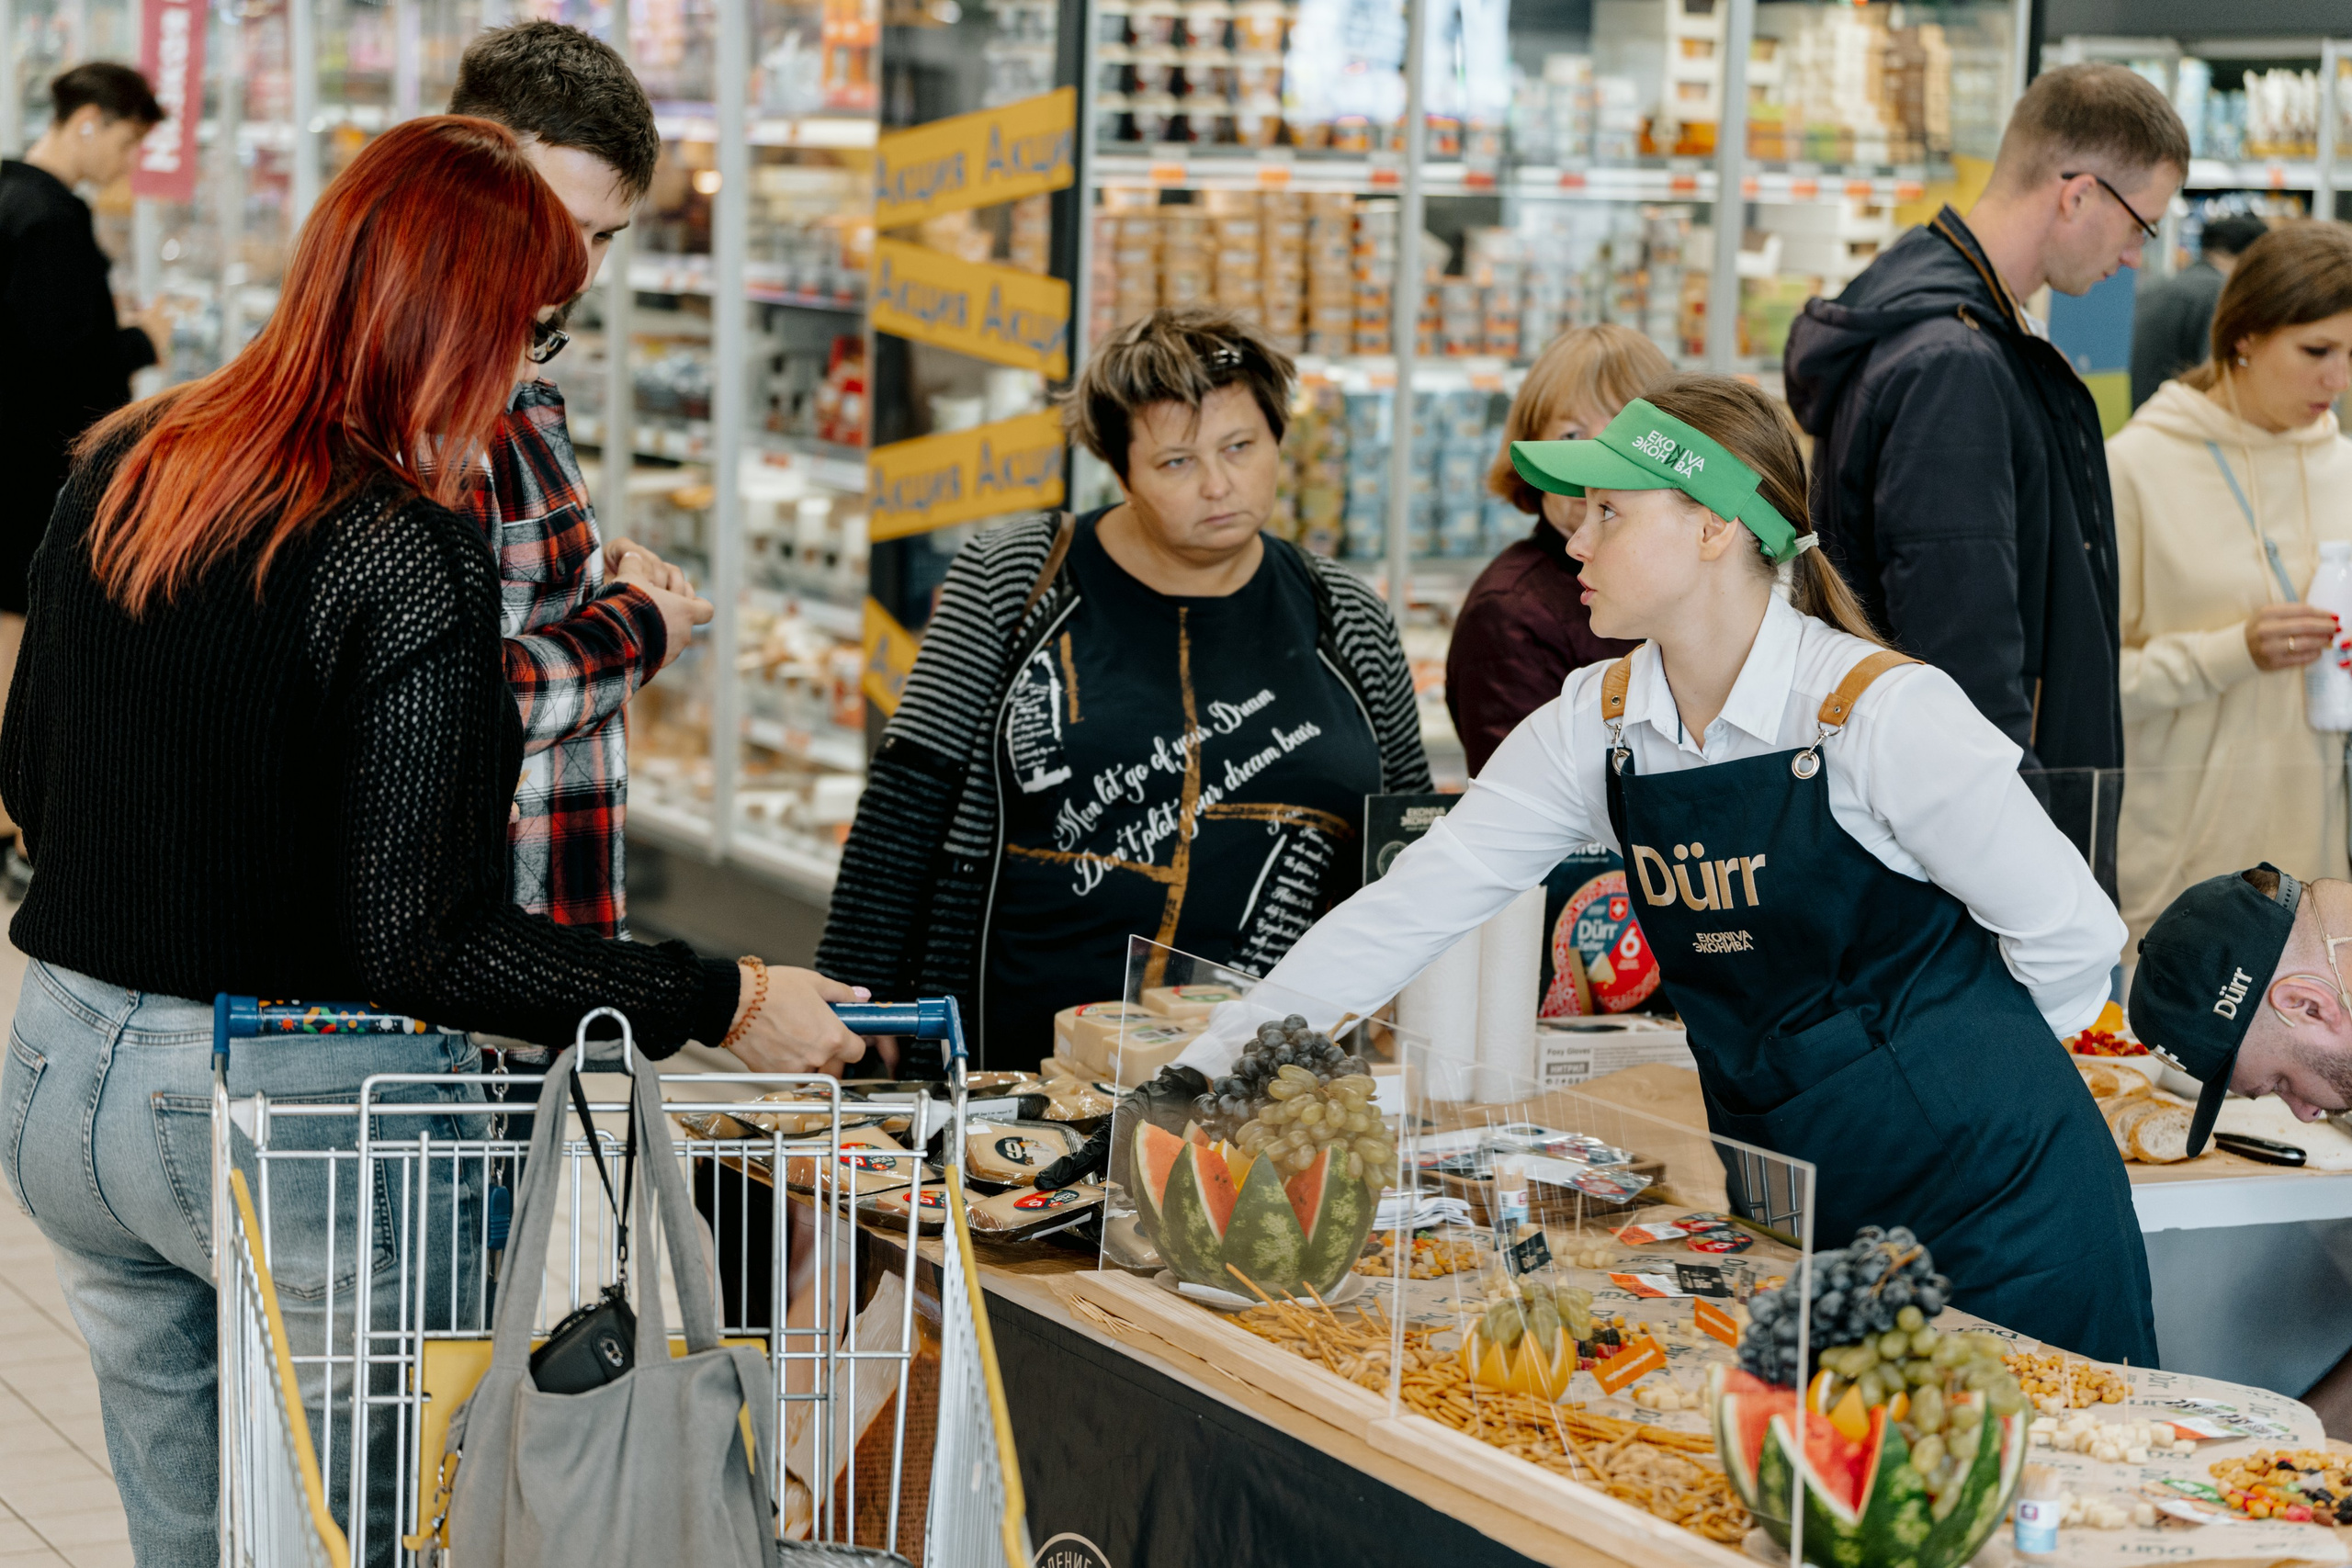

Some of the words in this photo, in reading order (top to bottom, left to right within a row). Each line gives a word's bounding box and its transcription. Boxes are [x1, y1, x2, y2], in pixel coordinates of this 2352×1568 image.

[1631, 435, 1693, 479] ЭКОНИВА
[1646, 429, 1706, 472] EKONIVA
[1093, 763, 1124, 805] let
[1125, 764, 1148, 805] go
[1150, 736, 1177, 774] of
[1171, 725, 1213, 772] your
[1207, 689, 1276, 734] Dream
[1224, 746, 1282, 791] dream
[1631, 841, 1767, 911] Dürr
[1577, 919, 1619, 941] Dürr
[1620, 927, 1641, 959] 6
[1692, 940, 1755, 953] ЭКОНИВА
[1695, 930, 1754, 943] EKONIVA
[2213, 966, 2253, 1021] Dürr
[1567, 1047, 1591, 1055] Gloves
